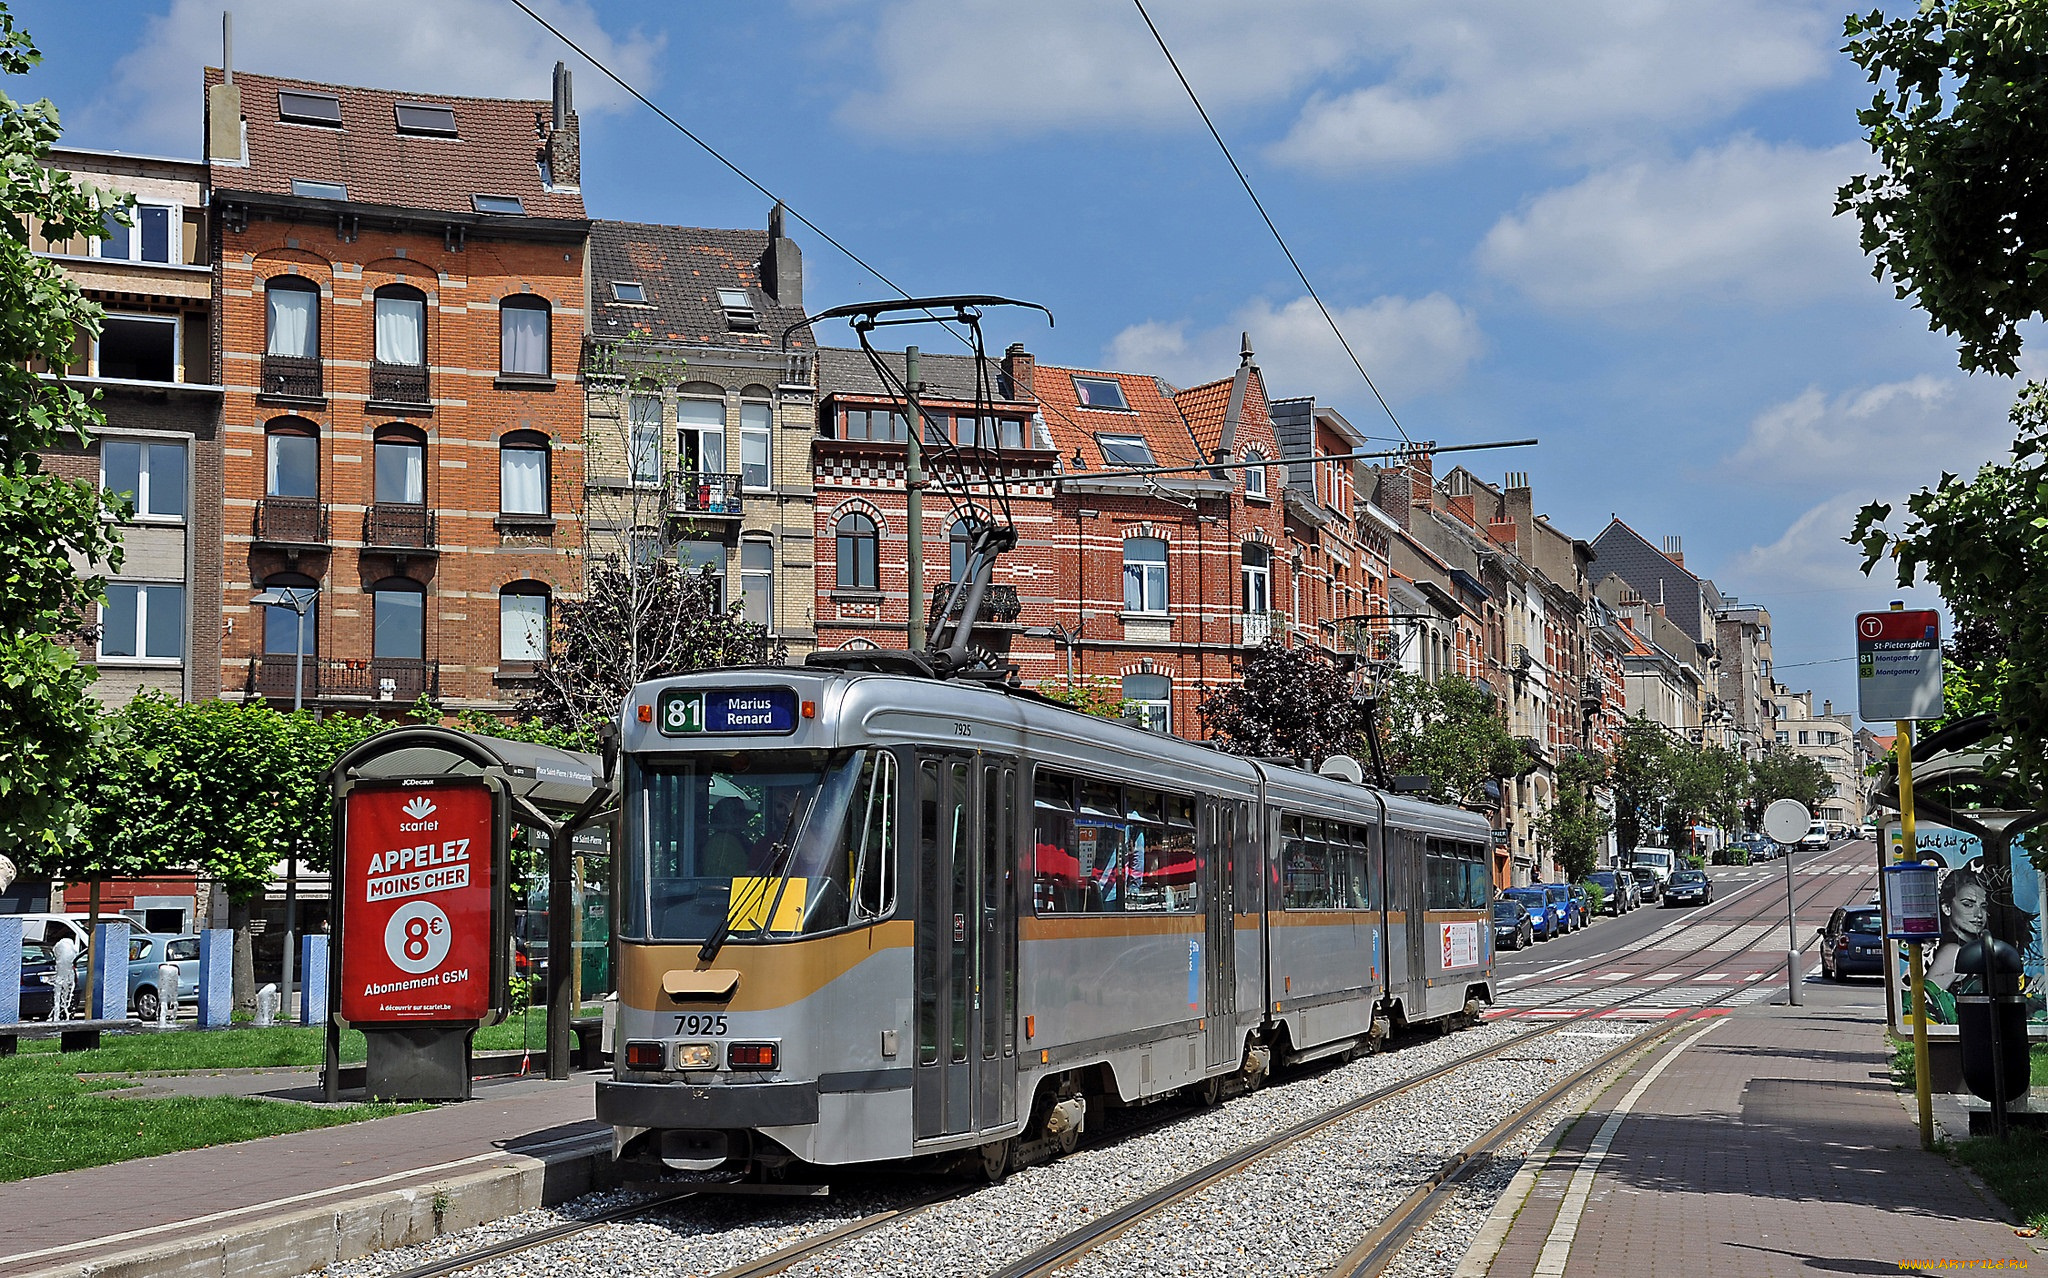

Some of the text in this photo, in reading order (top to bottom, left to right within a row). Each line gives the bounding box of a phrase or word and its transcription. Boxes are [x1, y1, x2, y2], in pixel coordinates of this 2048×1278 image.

[1874, 640, 1931, 650] St-Pietersplein
[1860, 655, 1920, 663] 81 Montgomery
[1860, 668, 1921, 676] 83 Montgomery
[728, 697, 771, 711] Marius
[667, 700, 700, 727] 81
[727, 712, 772, 725] Renard
[954, 722, 971, 736] 7925
[536, 766, 546, 775] Place
[400, 820, 439, 832] scarlet
[1916, 834, 1941, 848] What
[1944, 835, 1957, 847] did
[367, 838, 470, 875] APPELEZ
[371, 869, 465, 897] MOINS CHER
[364, 969, 469, 996] Abonnement GSM
[380, 1003, 385, 1011] À
[674, 1016, 728, 1036] 7925
